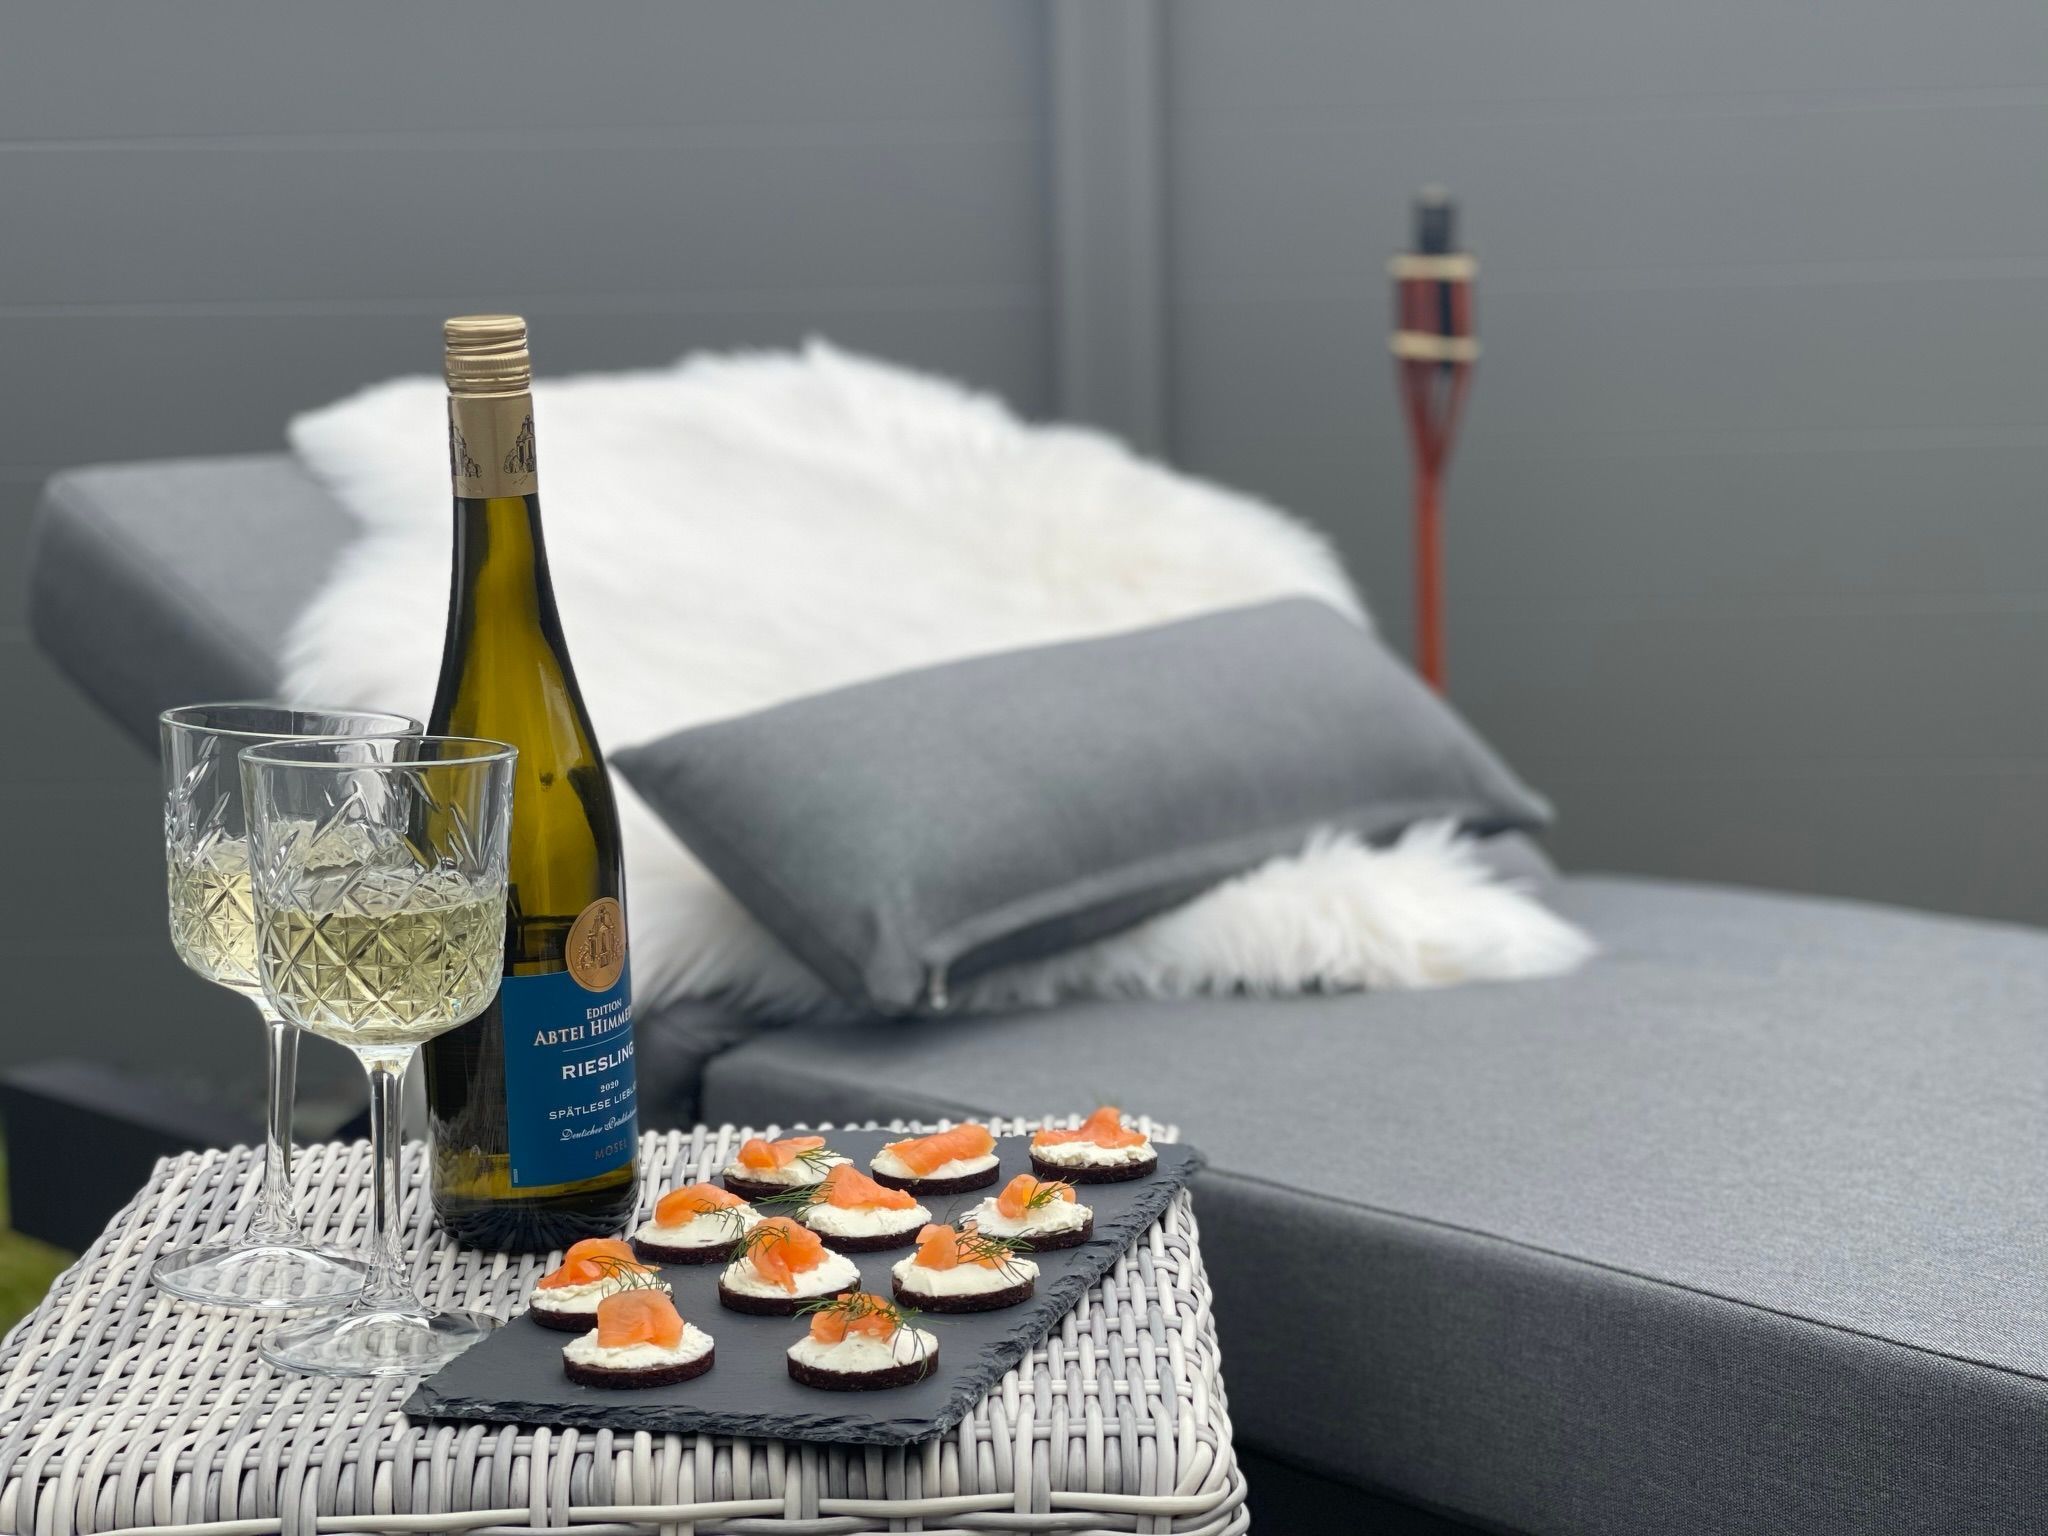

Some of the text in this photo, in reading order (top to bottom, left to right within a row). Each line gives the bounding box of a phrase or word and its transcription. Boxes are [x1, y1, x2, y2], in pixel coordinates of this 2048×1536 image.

[586, 998, 622, 1020] EDITION
[533, 1025, 585, 1046] ABTEI
[562, 1041, 634, 1080] RIESLING
[600, 1079, 619, 1093] 2020
[549, 1098, 611, 1120] SPÄTLESE
